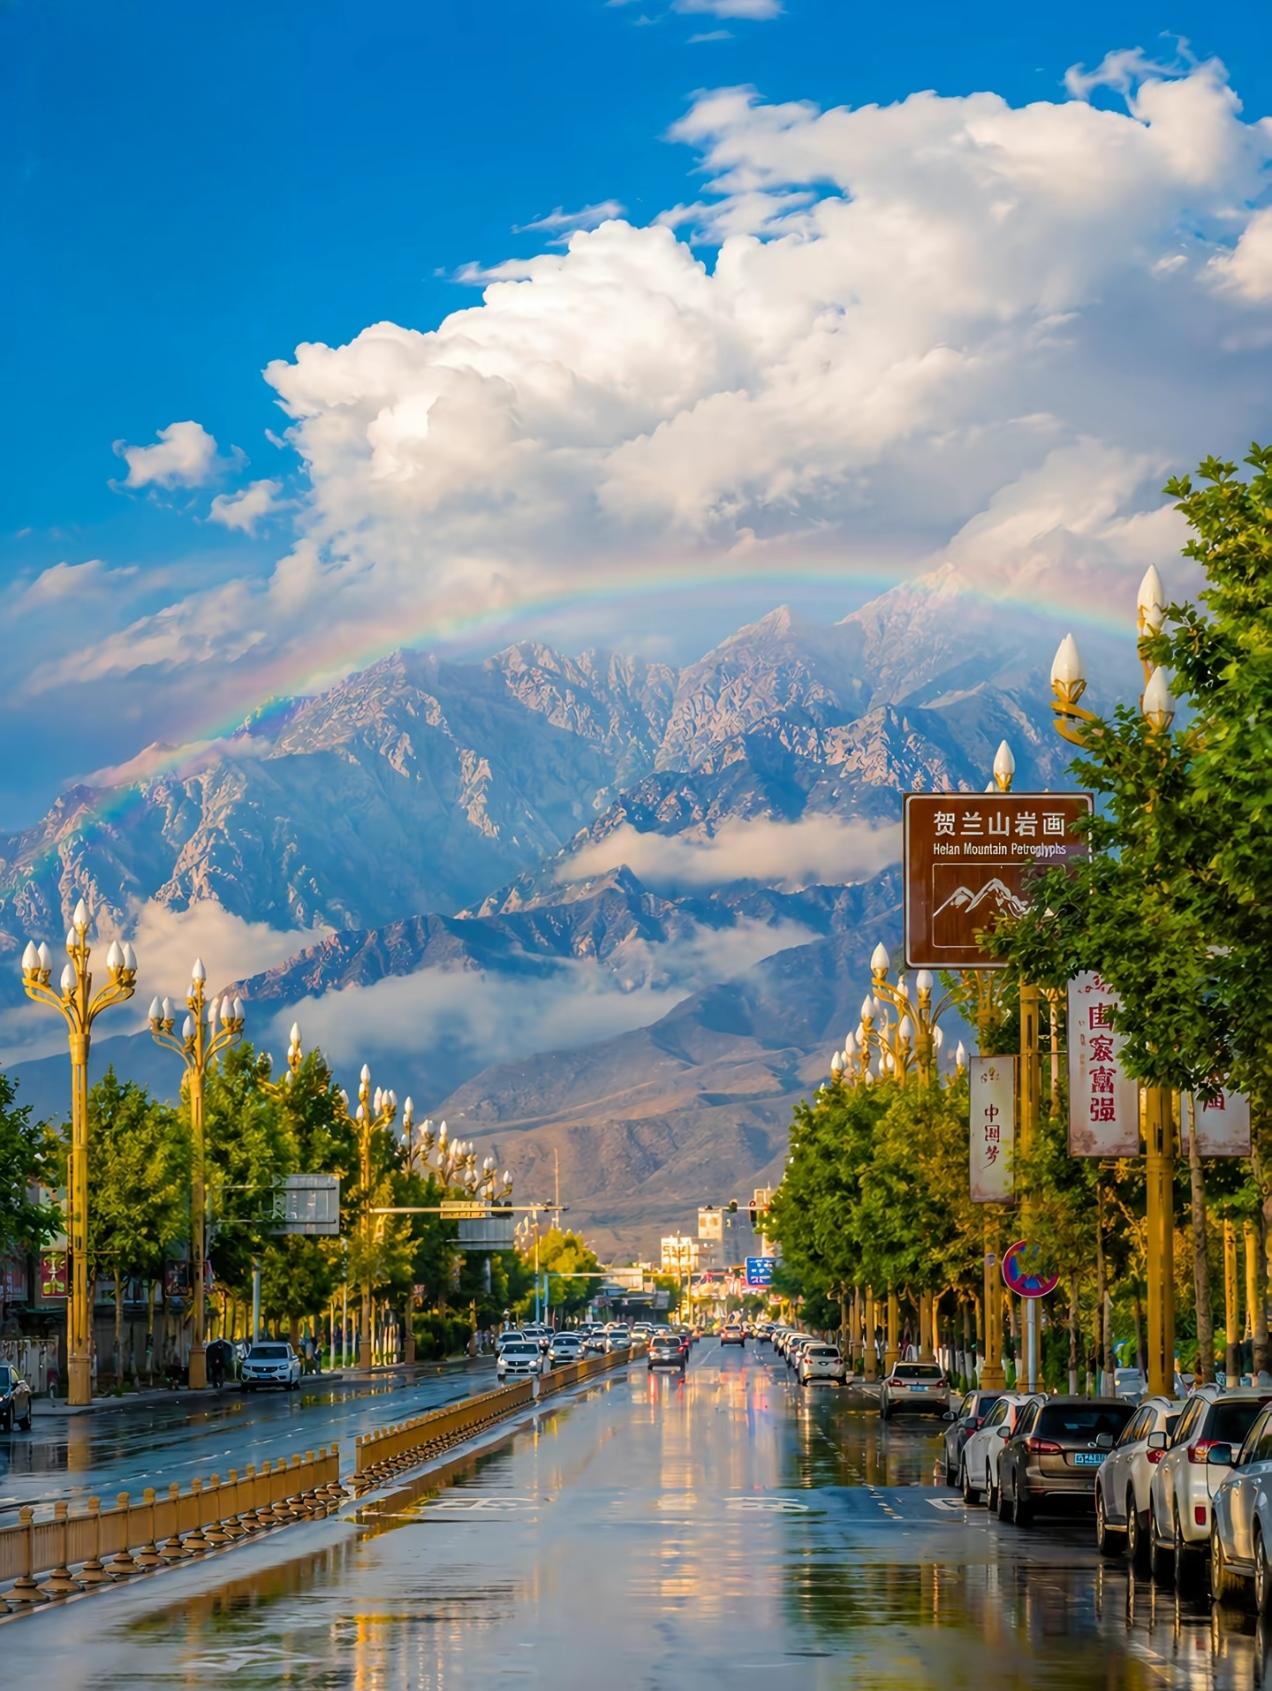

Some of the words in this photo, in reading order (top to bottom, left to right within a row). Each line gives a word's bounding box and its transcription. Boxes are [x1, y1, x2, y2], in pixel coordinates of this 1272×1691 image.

[933, 811, 1066, 837] 贺兰山岩画
[933, 842, 960, 855] Helan
[963, 842, 1007, 855] Mountain
[1011, 842, 1067, 858] Petroglyphs
[1089, 1003, 1116, 1121] 国家富强
[984, 1103, 1000, 1169] 中国梦
